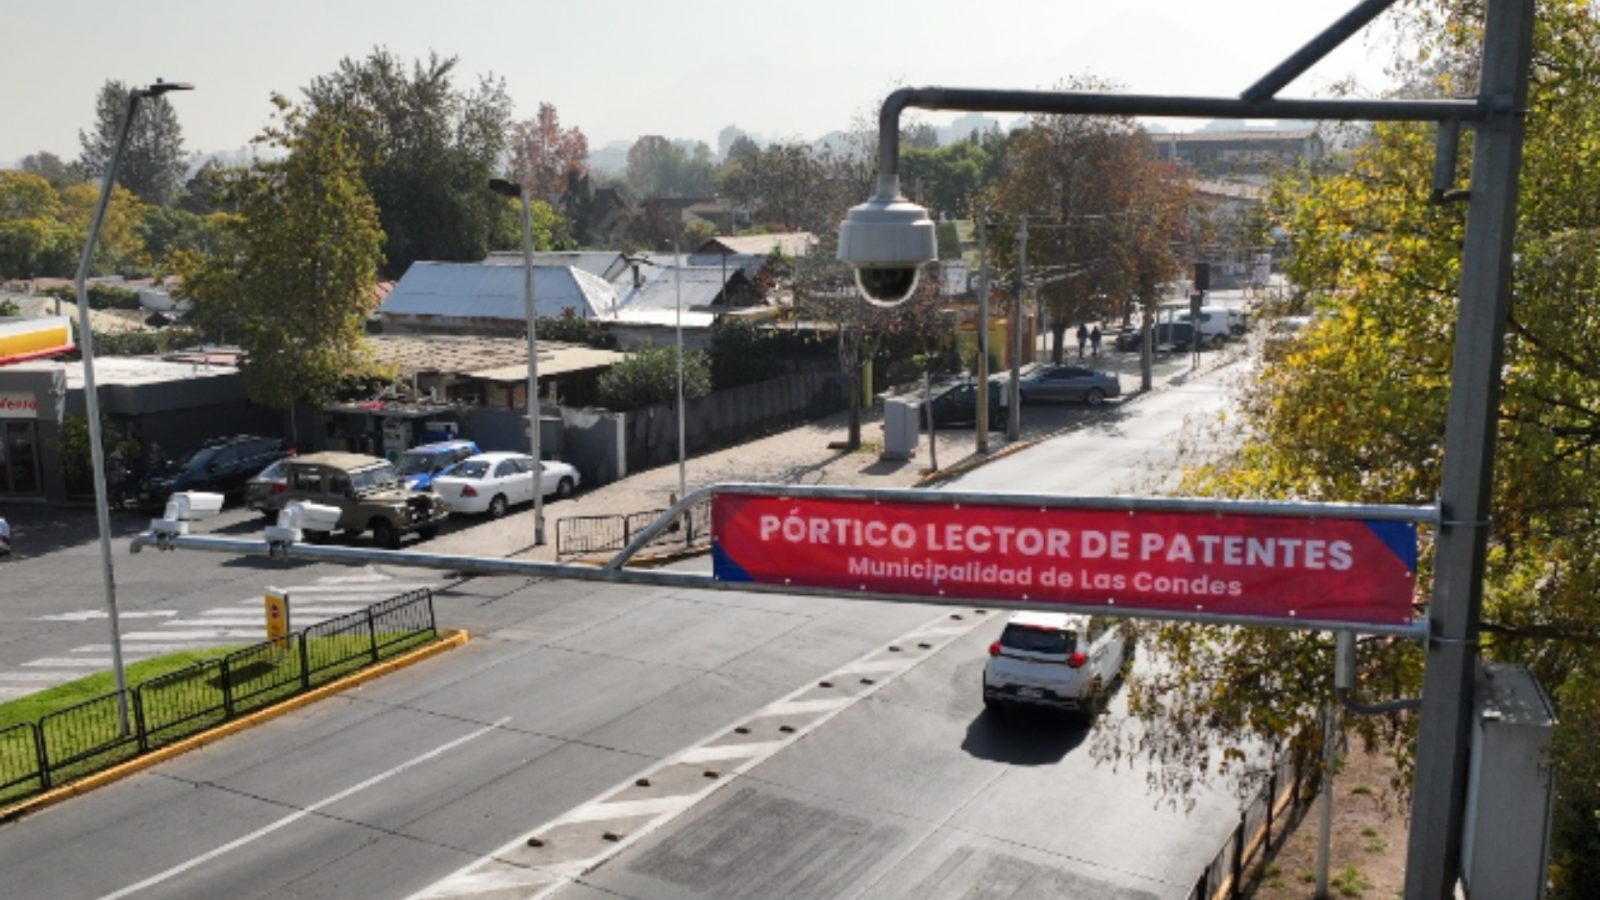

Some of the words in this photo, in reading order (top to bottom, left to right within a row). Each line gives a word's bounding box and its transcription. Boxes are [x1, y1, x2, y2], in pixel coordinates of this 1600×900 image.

[760, 508, 916, 548] PÓRTICO
[928, 524, 1070, 557] LECTOR
[1081, 531, 1130, 559] DE
[1141, 534, 1353, 570] PATENTES
[849, 558, 1031, 585] Municipalidad
[1041, 568, 1073, 588] de
[1081, 570, 1126, 590] Las
[1134, 572, 1242, 596] Condes
